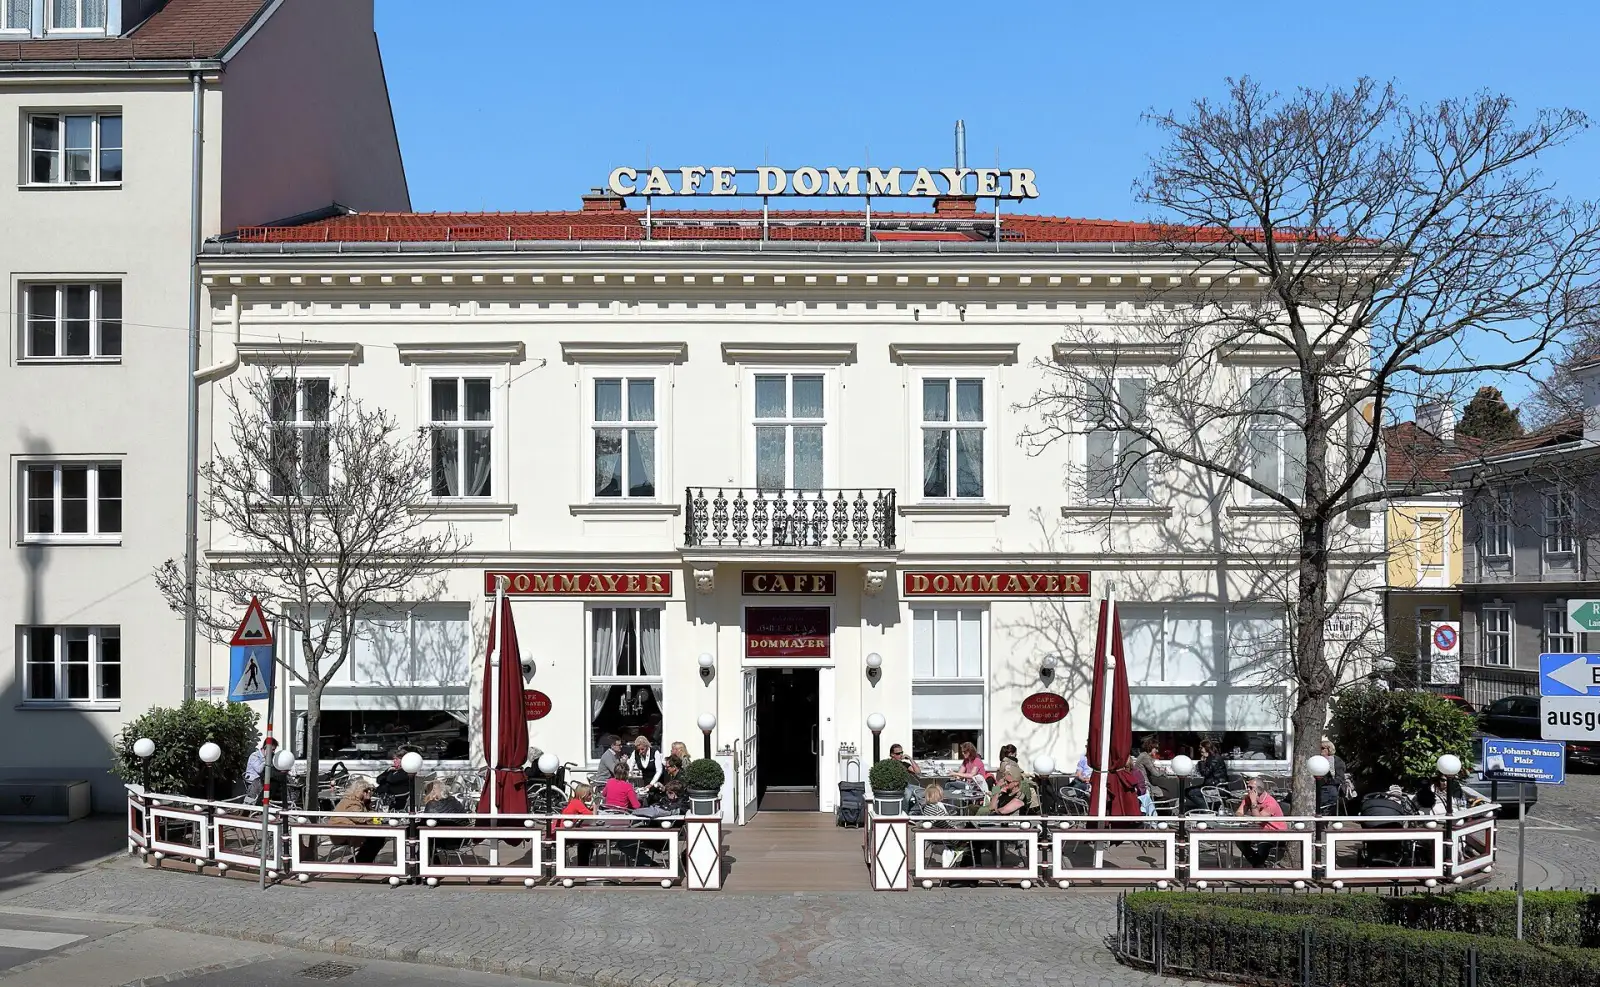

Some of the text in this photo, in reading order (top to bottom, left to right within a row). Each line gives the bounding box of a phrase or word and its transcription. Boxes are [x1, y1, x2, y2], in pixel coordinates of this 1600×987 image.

[608, 166, 1040, 198] CAFE DOMMAYER
[493, 574, 665, 592] DOMMAYER
[752, 575, 826, 592] CAFE
[912, 574, 1083, 592] DOMMAYER
[751, 639, 825, 648] DOMMAYER
[1547, 711, 1600, 731] ausg
[1502, 747, 1531, 756] Johann
[1532, 748, 1560, 757] Strauss
[1514, 756, 1534, 764] Platz
